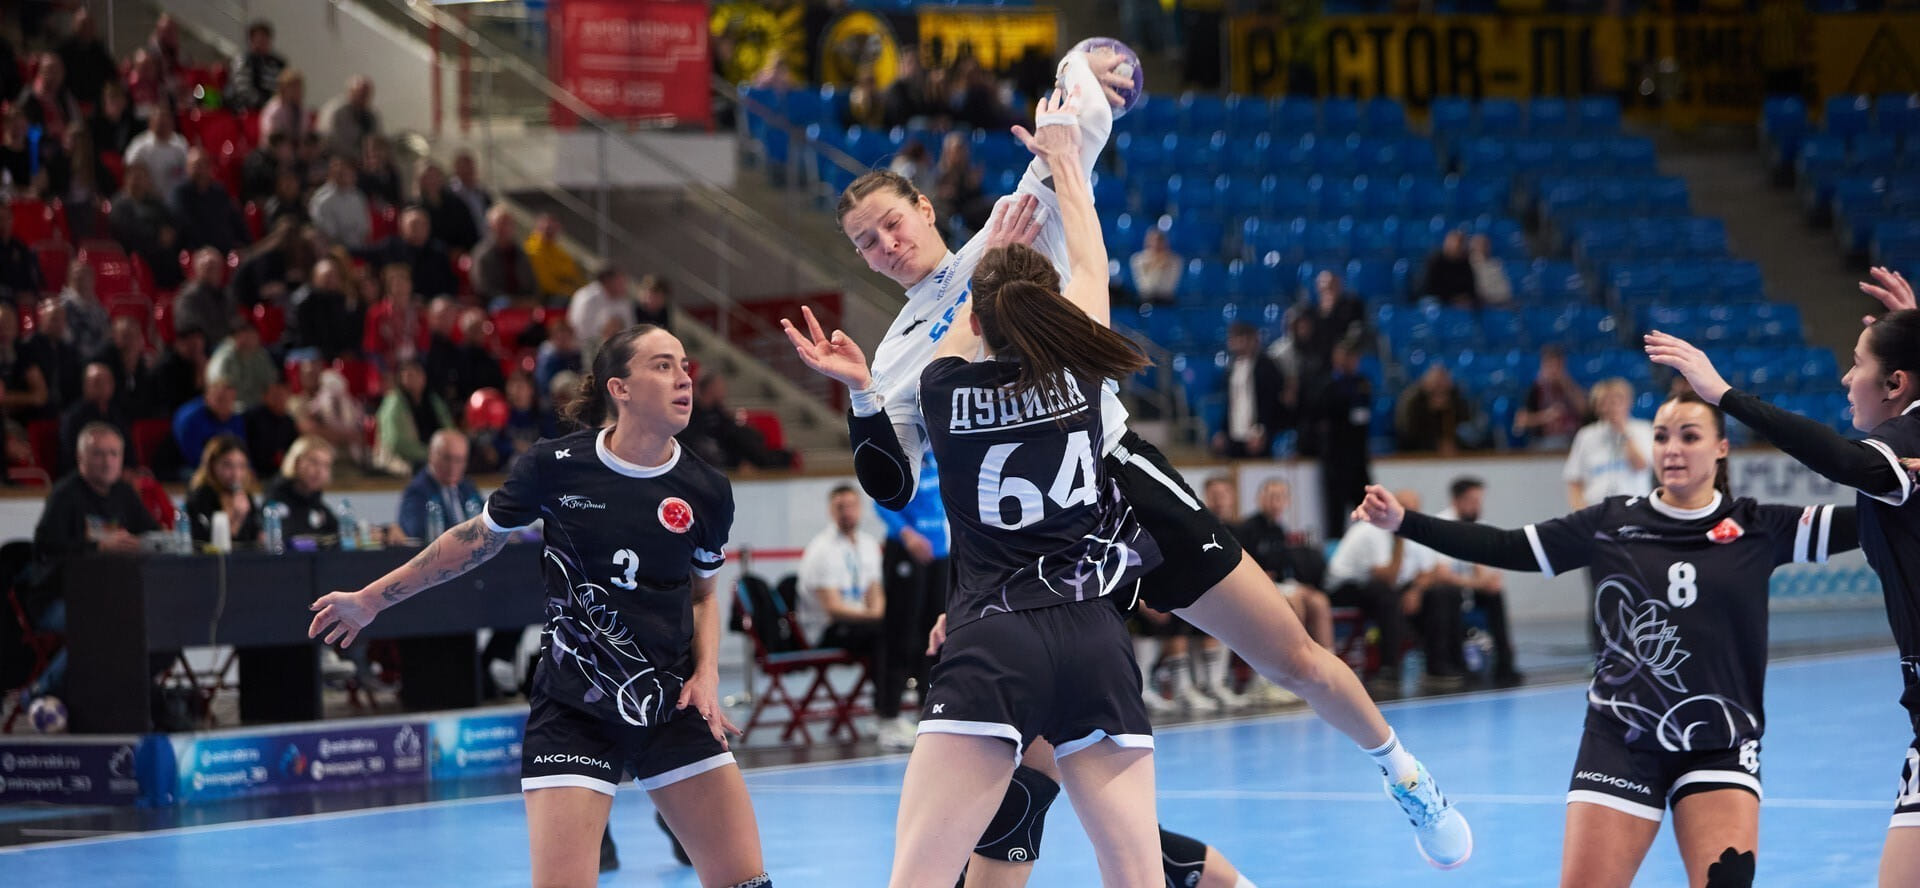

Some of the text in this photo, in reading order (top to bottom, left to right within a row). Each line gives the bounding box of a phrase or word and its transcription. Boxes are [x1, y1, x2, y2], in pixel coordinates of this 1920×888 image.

[977, 431, 1097, 530] 64
[610, 548, 640, 590] 3
[1667, 561, 1698, 609] 8
[533, 753, 612, 771] АКСИОМА
[1576, 770, 1652, 796] АКСИОМА
